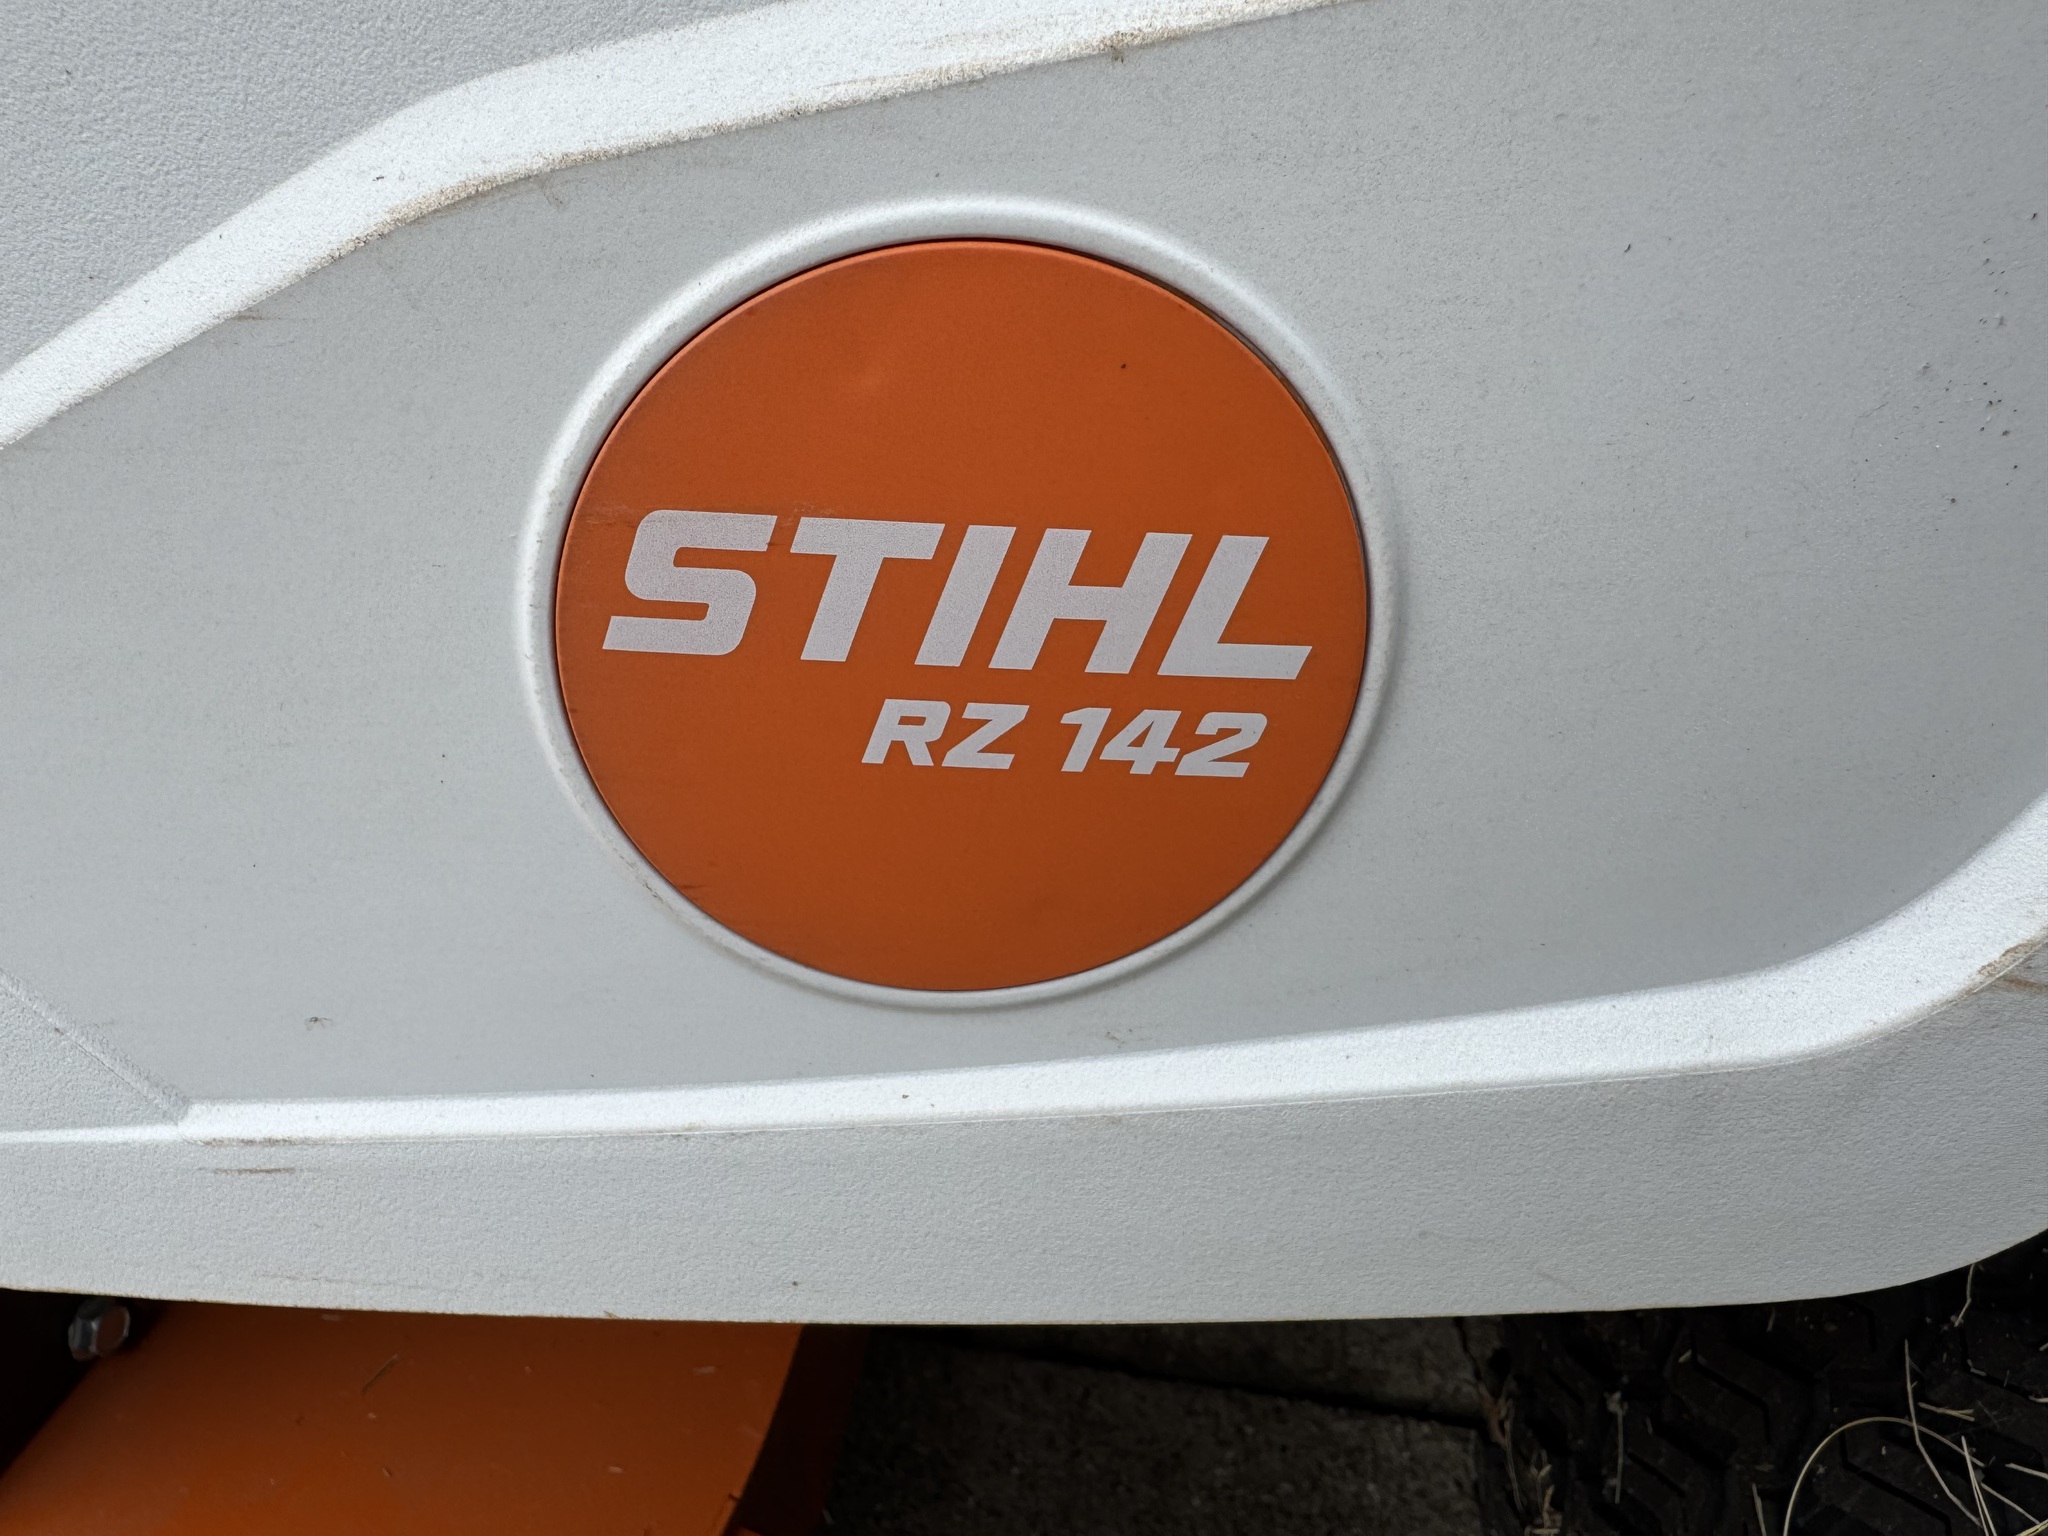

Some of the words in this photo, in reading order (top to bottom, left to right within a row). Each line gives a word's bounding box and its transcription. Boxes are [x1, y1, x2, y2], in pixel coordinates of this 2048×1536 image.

[602, 509, 1313, 680] STIHL
[861, 698, 1030, 770] RZ
[1060, 707, 1268, 778] 142
